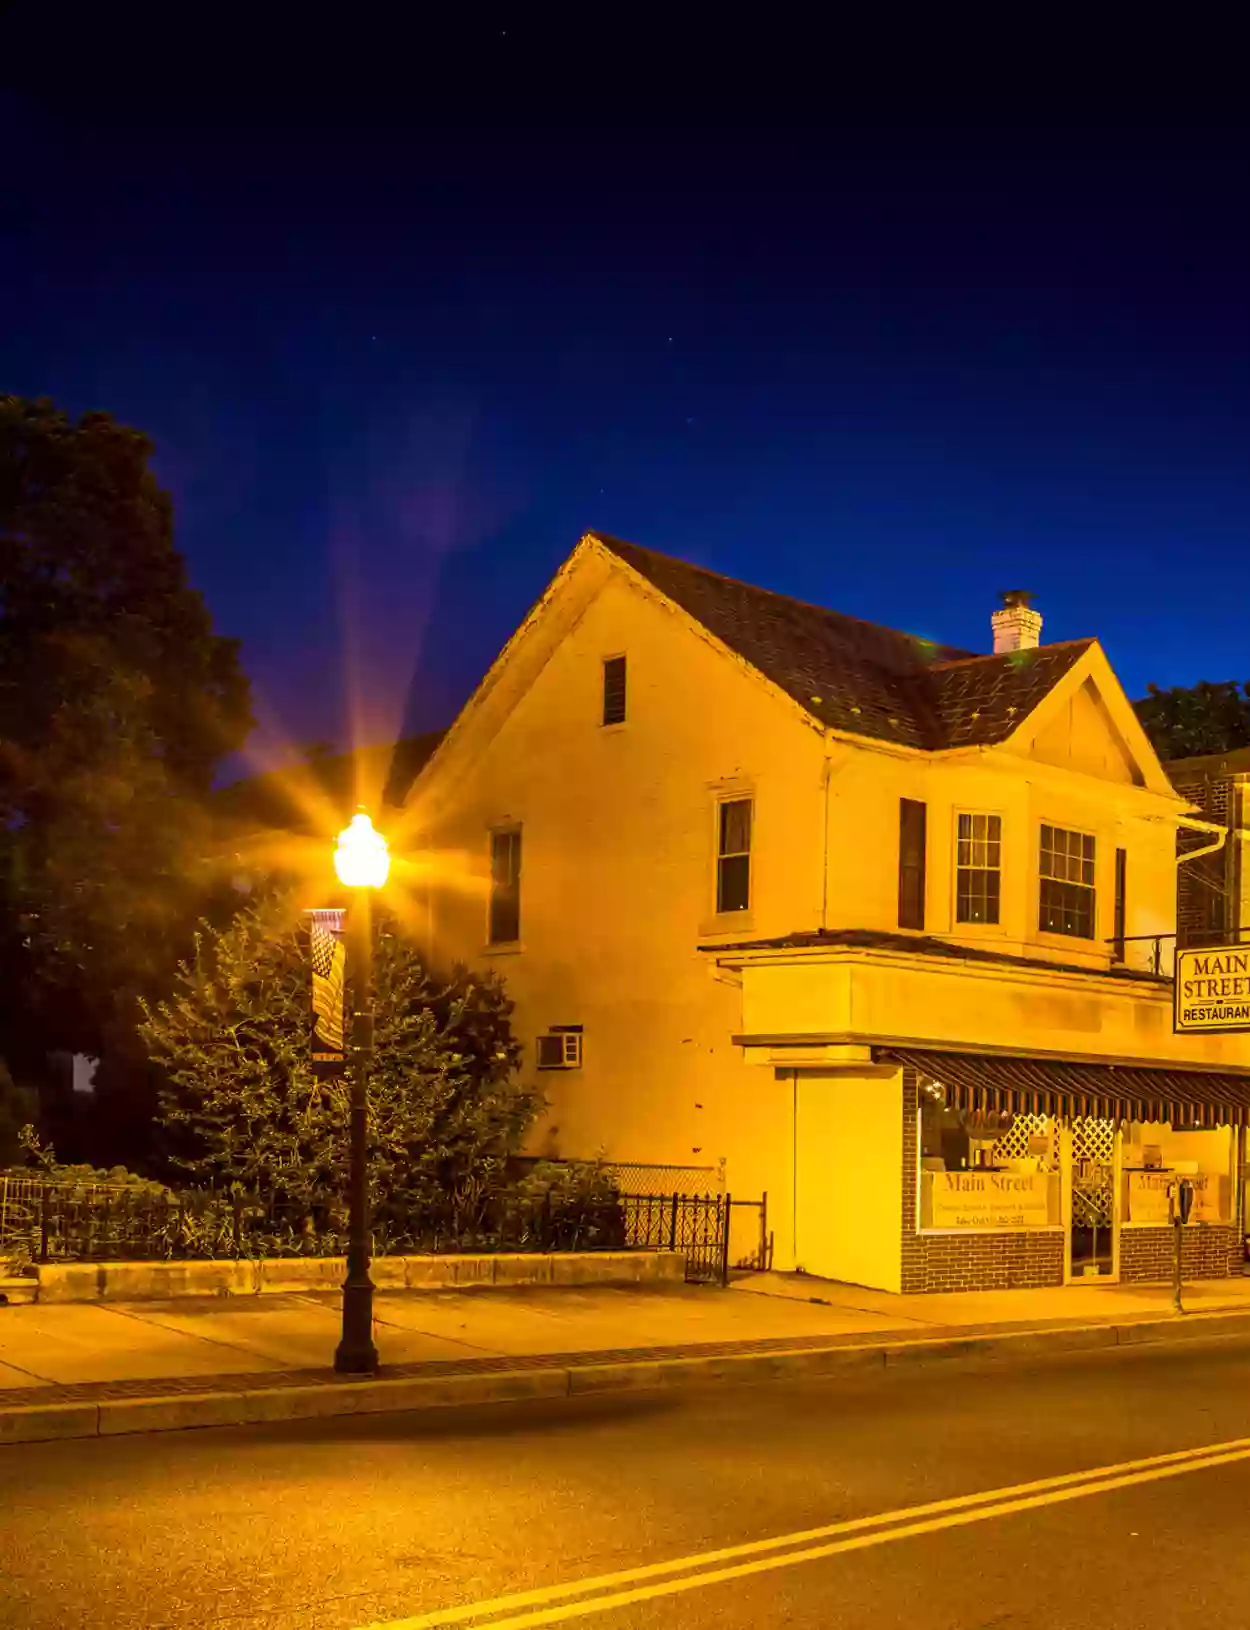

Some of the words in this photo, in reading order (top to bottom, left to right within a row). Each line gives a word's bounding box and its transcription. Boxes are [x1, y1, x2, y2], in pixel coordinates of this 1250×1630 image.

[1193, 955, 1248, 975] MAIN
[943, 1173, 985, 1192] Main
[991, 1173, 1034, 1192] Street
